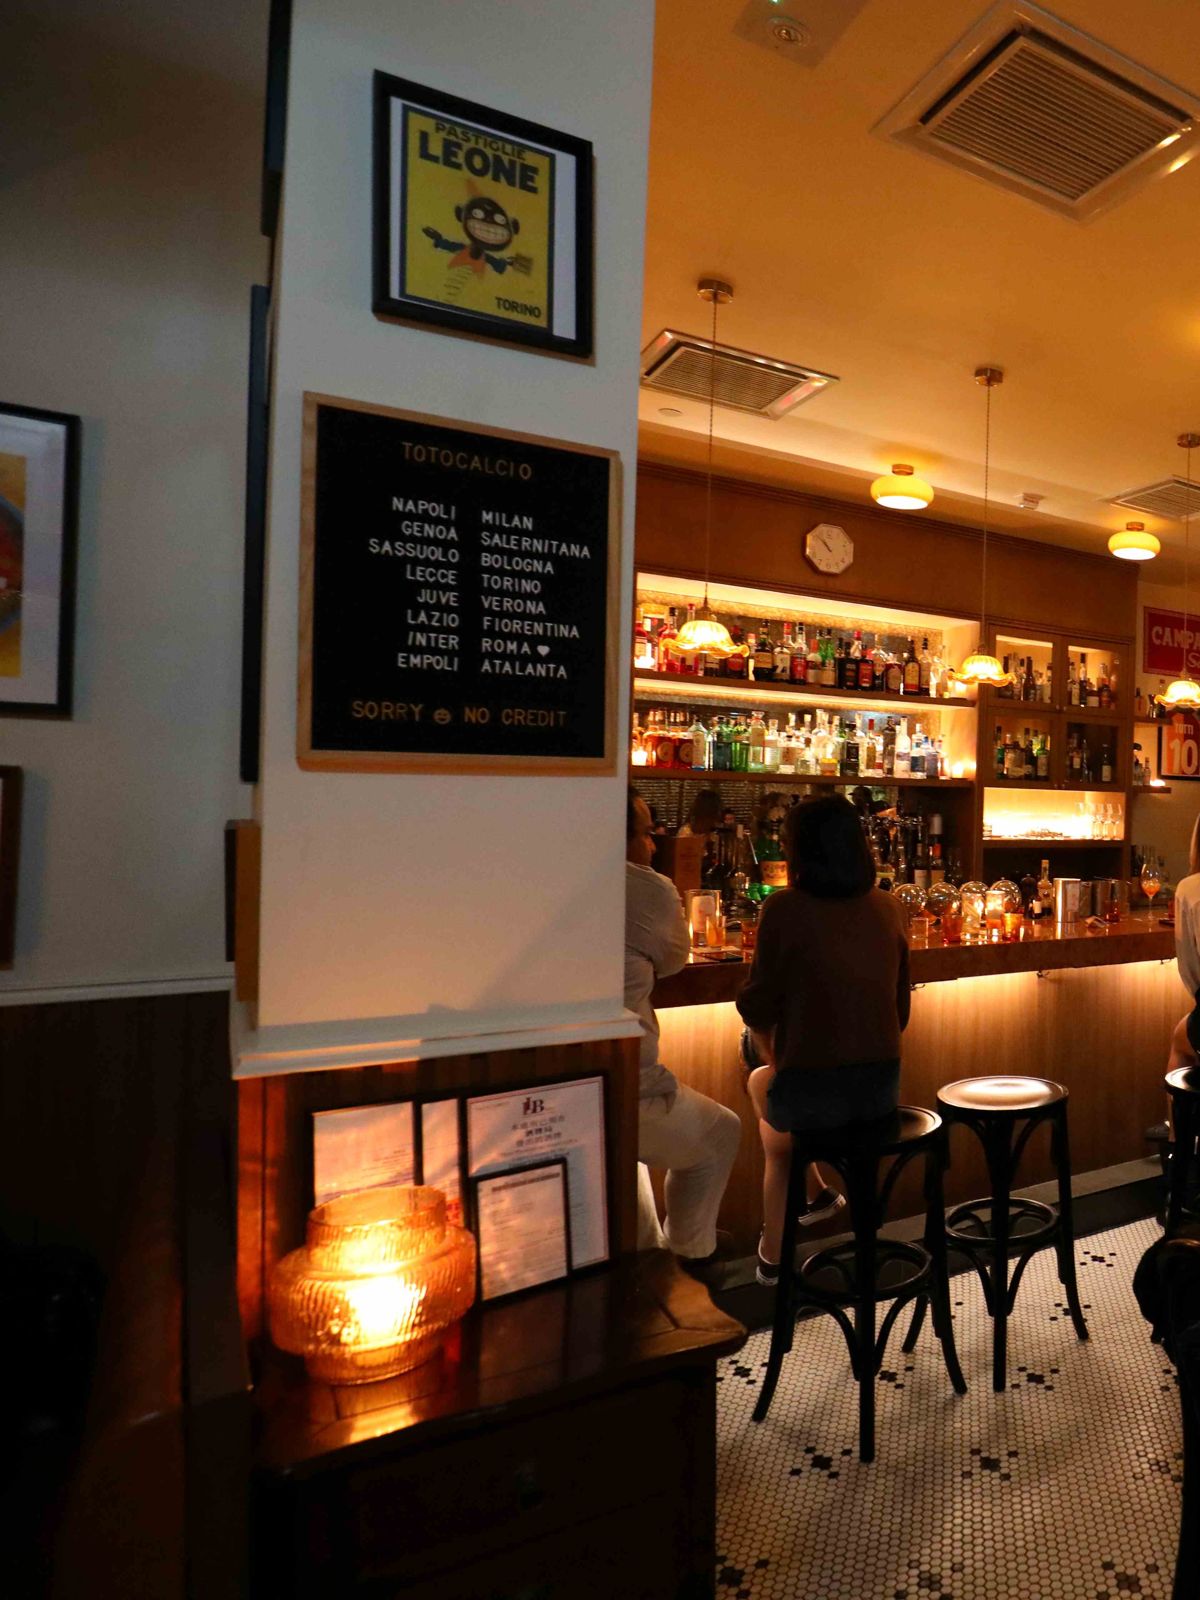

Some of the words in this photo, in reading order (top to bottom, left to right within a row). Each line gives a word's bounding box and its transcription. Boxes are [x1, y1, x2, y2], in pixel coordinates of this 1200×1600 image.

[435, 121, 526, 161] PASTIGLIE
[418, 129, 540, 195] LEONE
[495, 296, 542, 319] TORINO
[402, 441, 533, 481] TOTOCALCIO
[392, 496, 456, 520] NAPOLI
[481, 509, 534, 531] MILAN
[369, 538, 460, 563] SASSUOLO
[481, 552, 555, 575] BOLOGNA
[401, 520, 459, 542] GENOA
[481, 531, 591, 560] SALERNITANA
[406, 564, 458, 585] LECCE
[481, 574, 542, 595] TORINO
[417, 589, 460, 607] JUVE
[481, 595, 547, 616] VERONA
[406, 609, 460, 628] LAZIO
[483, 616, 580, 639] FIORENTINA
[408, 631, 460, 650] INTER
[481, 638, 532, 655] ROMA
[397, 652, 459, 672] EMPOLI
[481, 659, 568, 680] ATALANTA
[351, 700, 424, 723] SORRY
[464, 706, 491, 724] NO
[501, 708, 568, 728] CREDIT
[1169, 738, 1198, 775] 10
